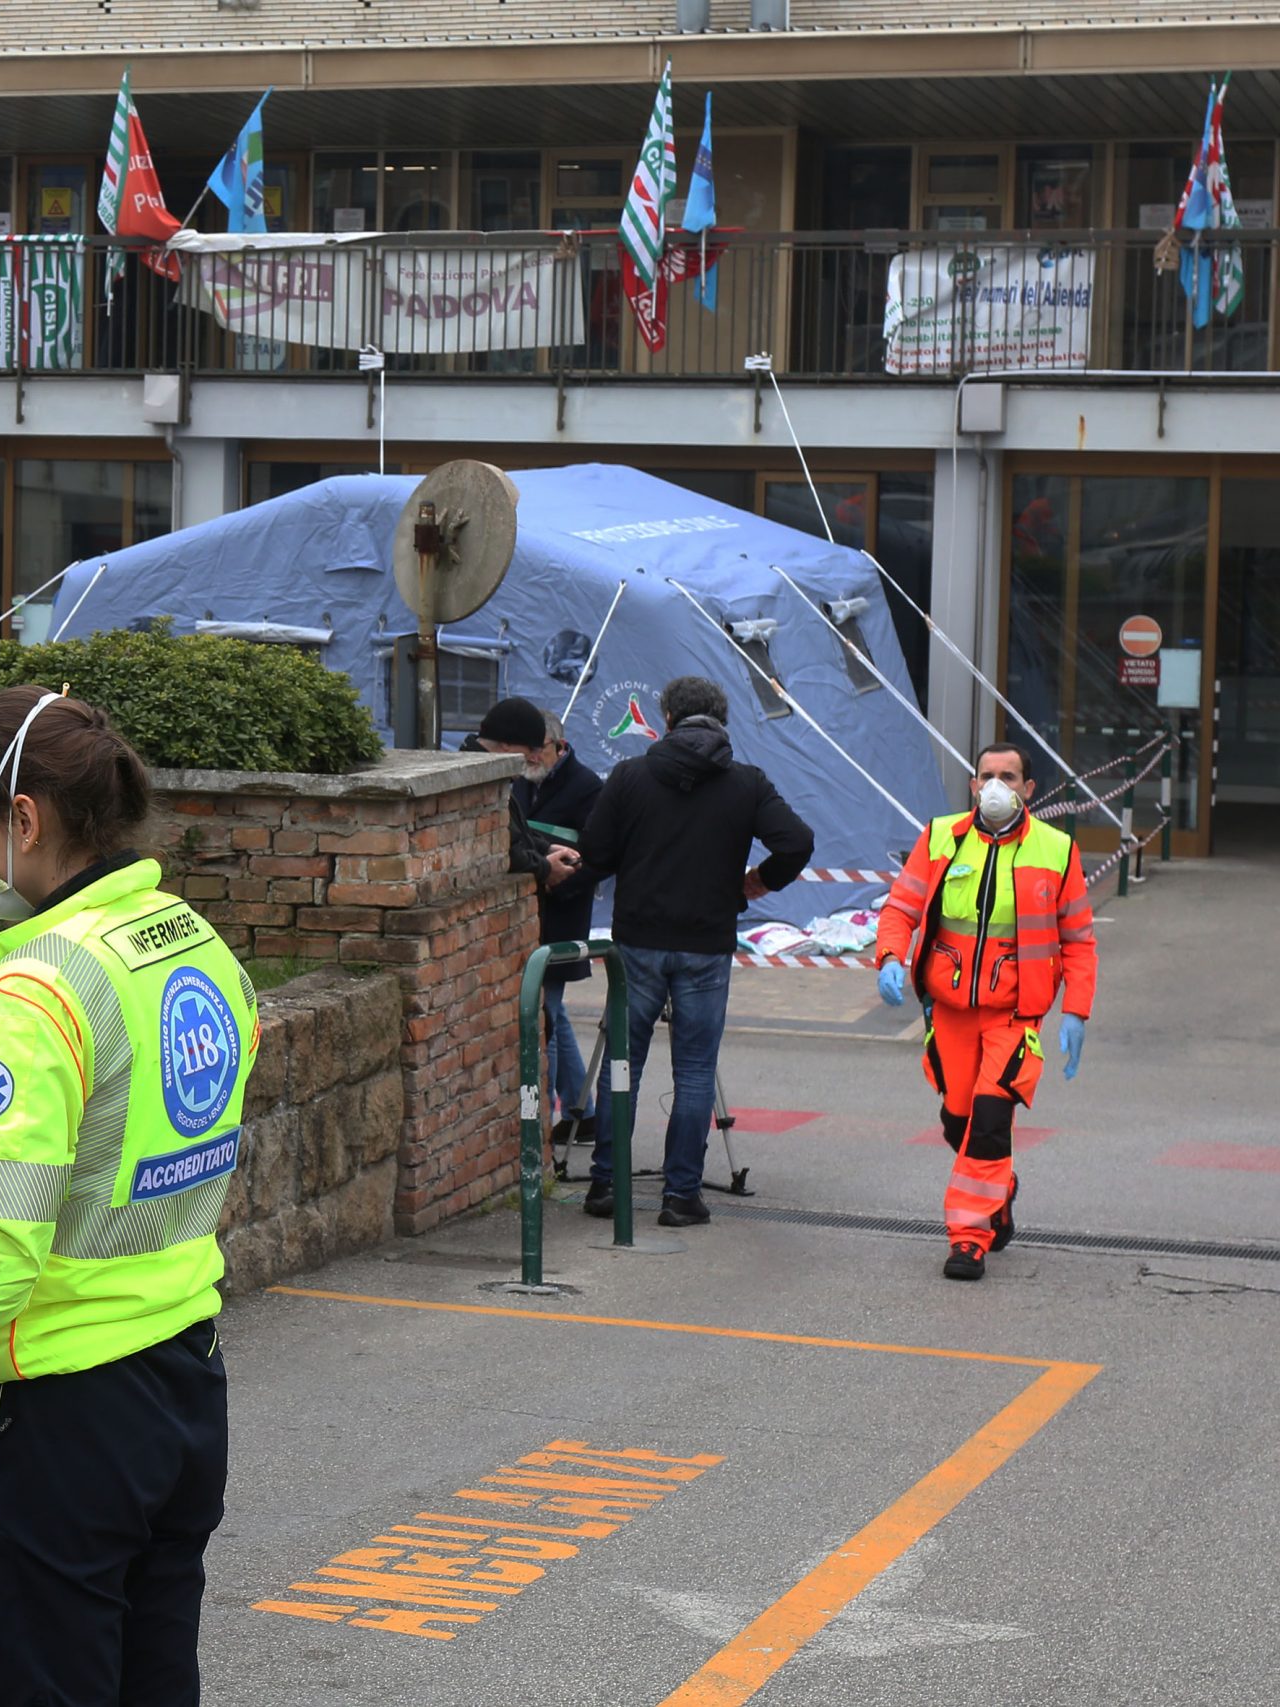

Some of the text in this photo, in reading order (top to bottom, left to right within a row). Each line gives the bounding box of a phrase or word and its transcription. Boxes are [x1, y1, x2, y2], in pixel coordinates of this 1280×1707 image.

[44, 289, 57, 336] CISL
[384, 281, 539, 319] PADOVA
[1124, 660, 1156, 668] VIETATO
[592, 681, 649, 726] PROTEZIONE
[127, 912, 200, 956] INFERMIERE
[162, 976, 238, 1089] SERVIZIO URGENZA EMERGENZA MEDICA
[178, 1023, 220, 1077] 118
[208, 1089, 228, 1121] VENETO
[137, 1139, 235, 1192] ACCREDITATO
[250, 1439, 728, 1642] AMBULANZE
